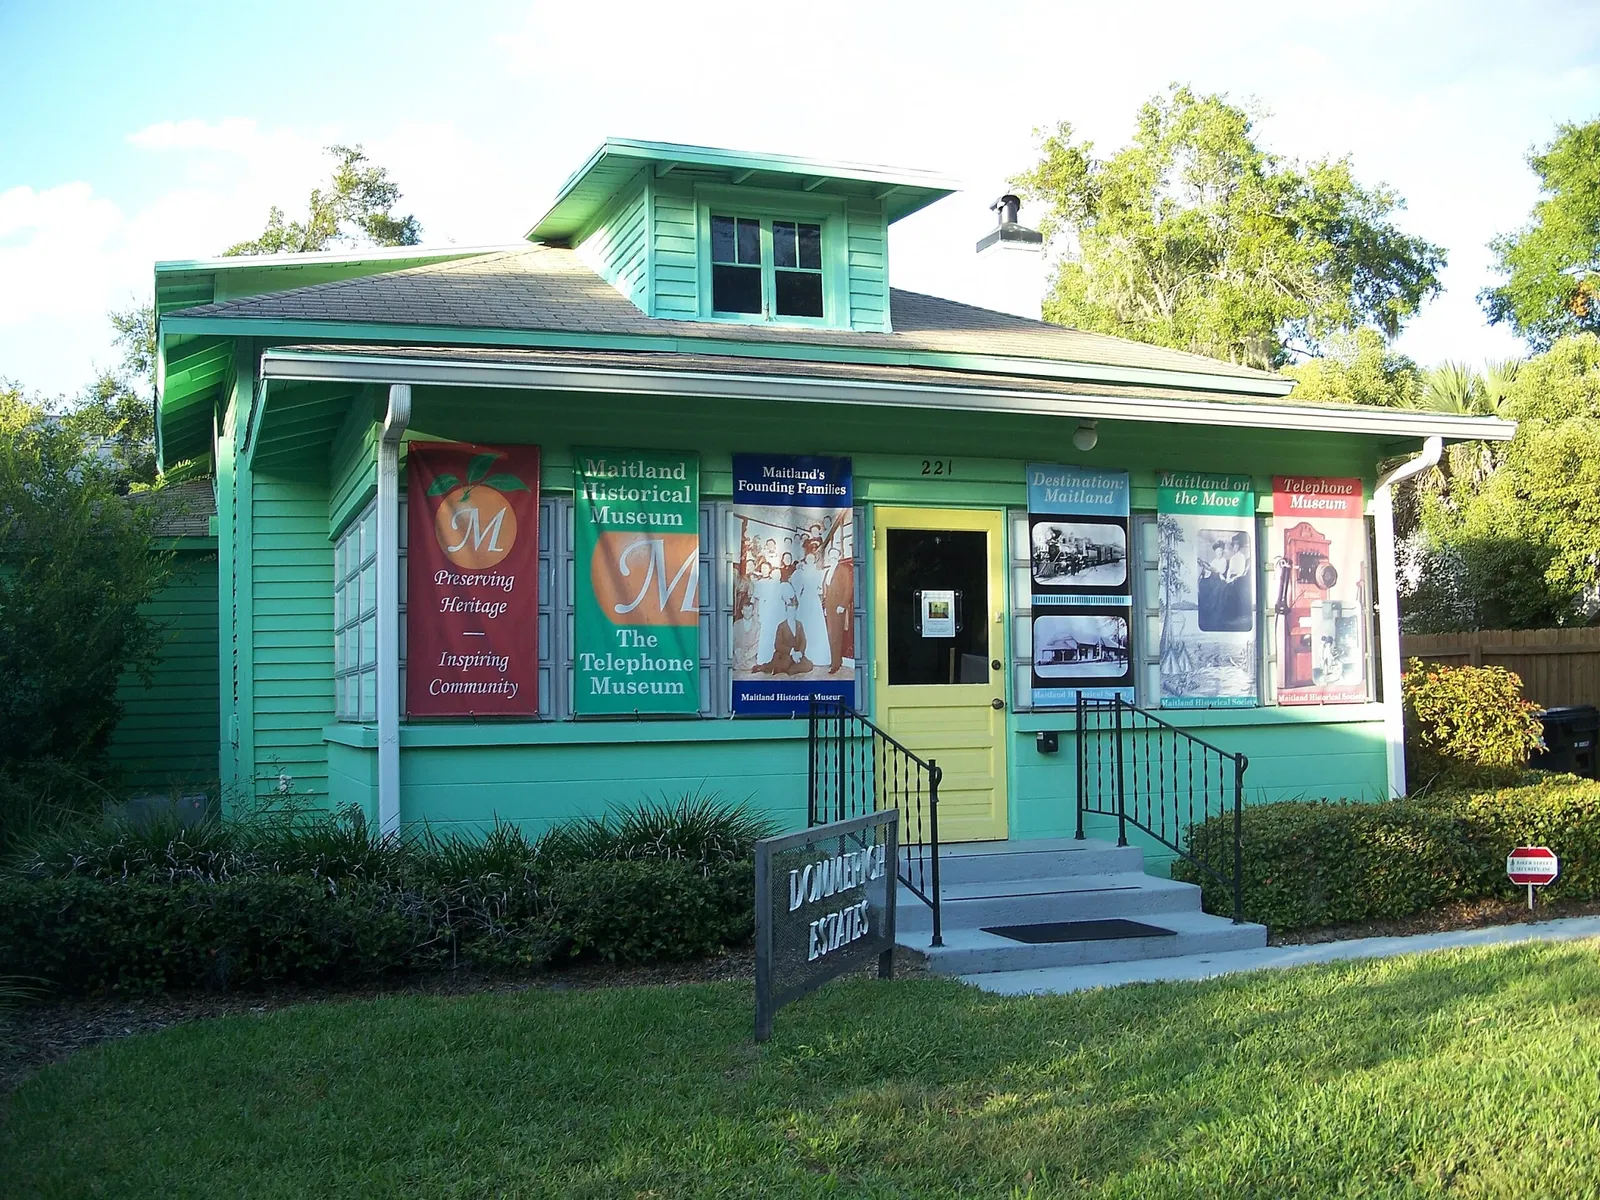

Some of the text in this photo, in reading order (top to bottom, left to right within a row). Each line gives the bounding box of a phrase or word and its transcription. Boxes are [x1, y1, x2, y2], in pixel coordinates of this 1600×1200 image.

[586, 459, 686, 480] Maitland
[763, 466, 825, 480] Maitland's
[921, 460, 952, 475] 221
[738, 480, 846, 495] Founding Families
[1033, 472, 1124, 489] Destination:
[1160, 474, 1250, 491] Maitland on
[1284, 479, 1353, 496] Telephone
[581, 482, 691, 504] Historical
[1044, 488, 1114, 504] Maitland
[1175, 491, 1239, 507] the Move
[1290, 494, 1347, 510] Museum
[590, 506, 683, 526] Museum
[448, 507, 507, 552] M
[434, 570, 515, 592] Preserving
[614, 539, 700, 614] M
[440, 596, 507, 618] Heritage
[616, 629, 658, 648] The
[438, 651, 509, 672] Inspiring
[580, 653, 694, 675] Telephone
[429, 678, 519, 699] Community
[590, 677, 685, 695] Museum
[741, 693, 775, 701] Maitland
[776, 693, 810, 701] Historica
[1161, 698, 1258, 707] Maitland Historical Society
[1278, 694, 1308, 702] Maitland
[1310, 693, 1341, 701] Historical
[808, 900, 869, 961] ESTATES
